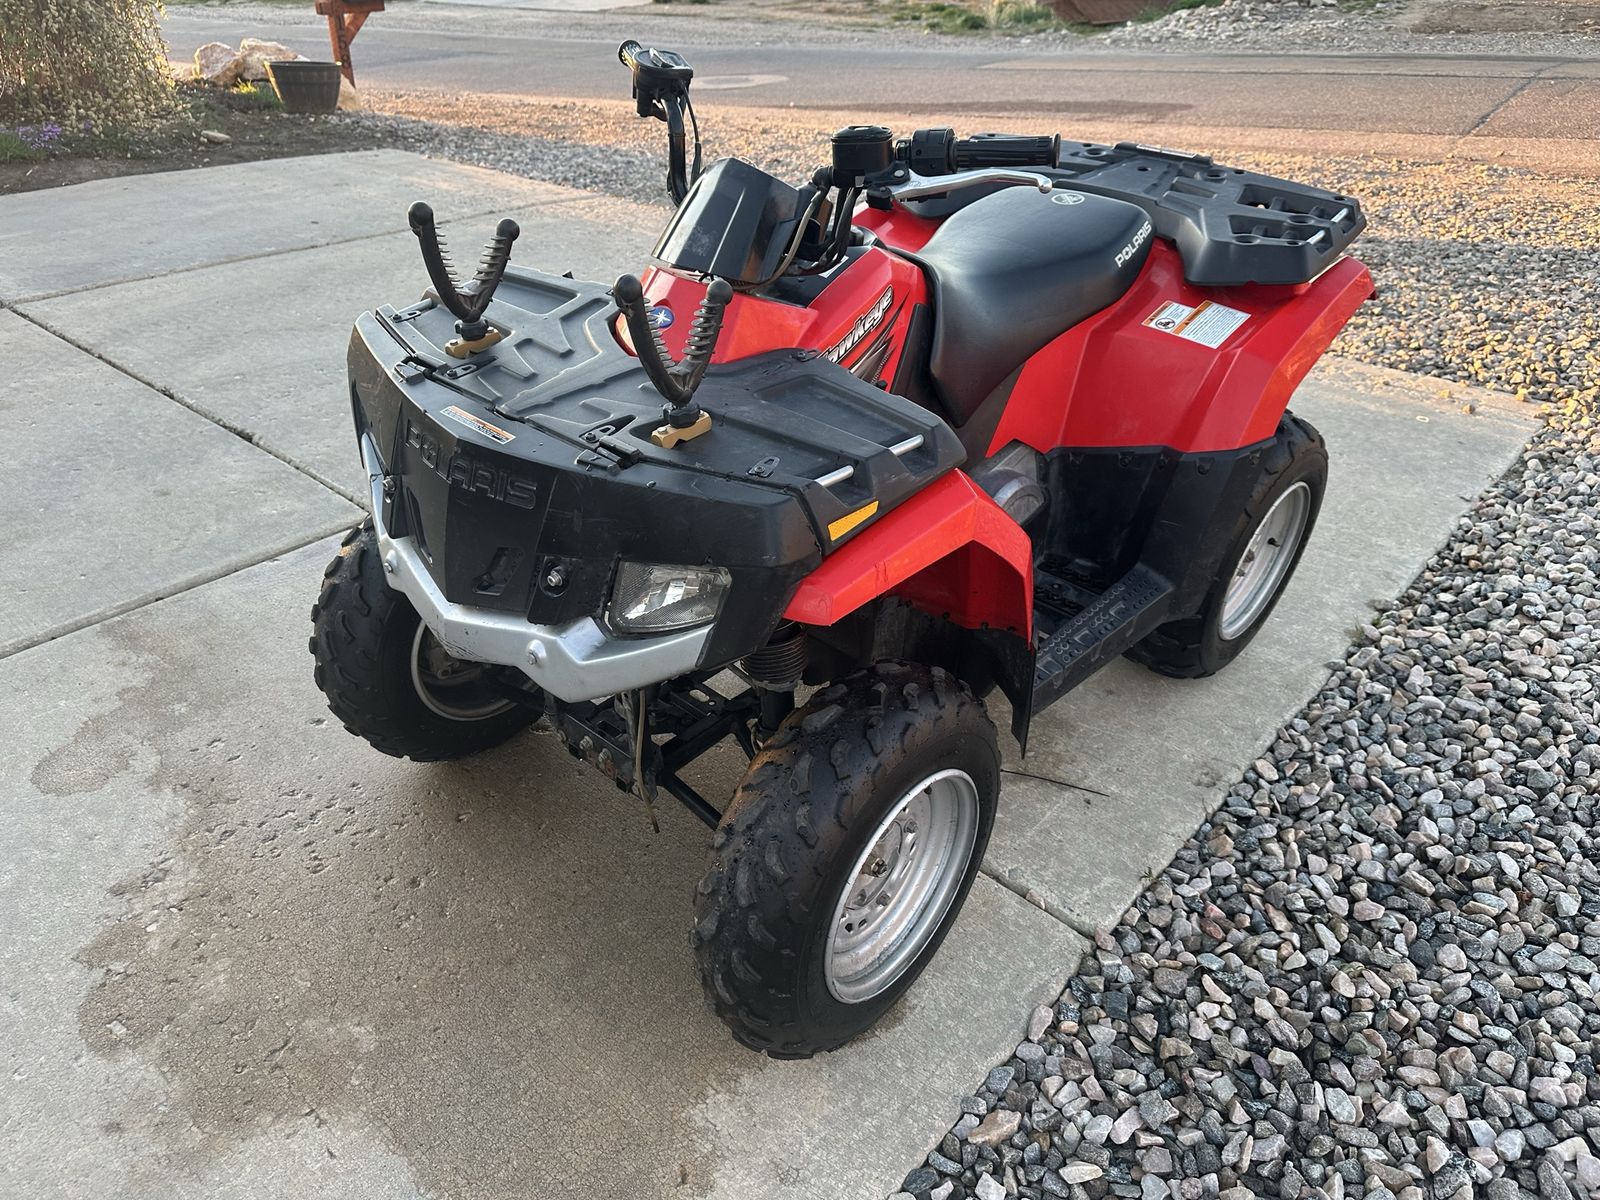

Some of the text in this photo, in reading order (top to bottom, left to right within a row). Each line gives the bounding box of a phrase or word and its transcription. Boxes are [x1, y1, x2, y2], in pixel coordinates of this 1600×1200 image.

[1114, 220, 1152, 268] POLARIS
[820, 285, 894, 364] awkeye
[406, 419, 538, 510] POLARIS
